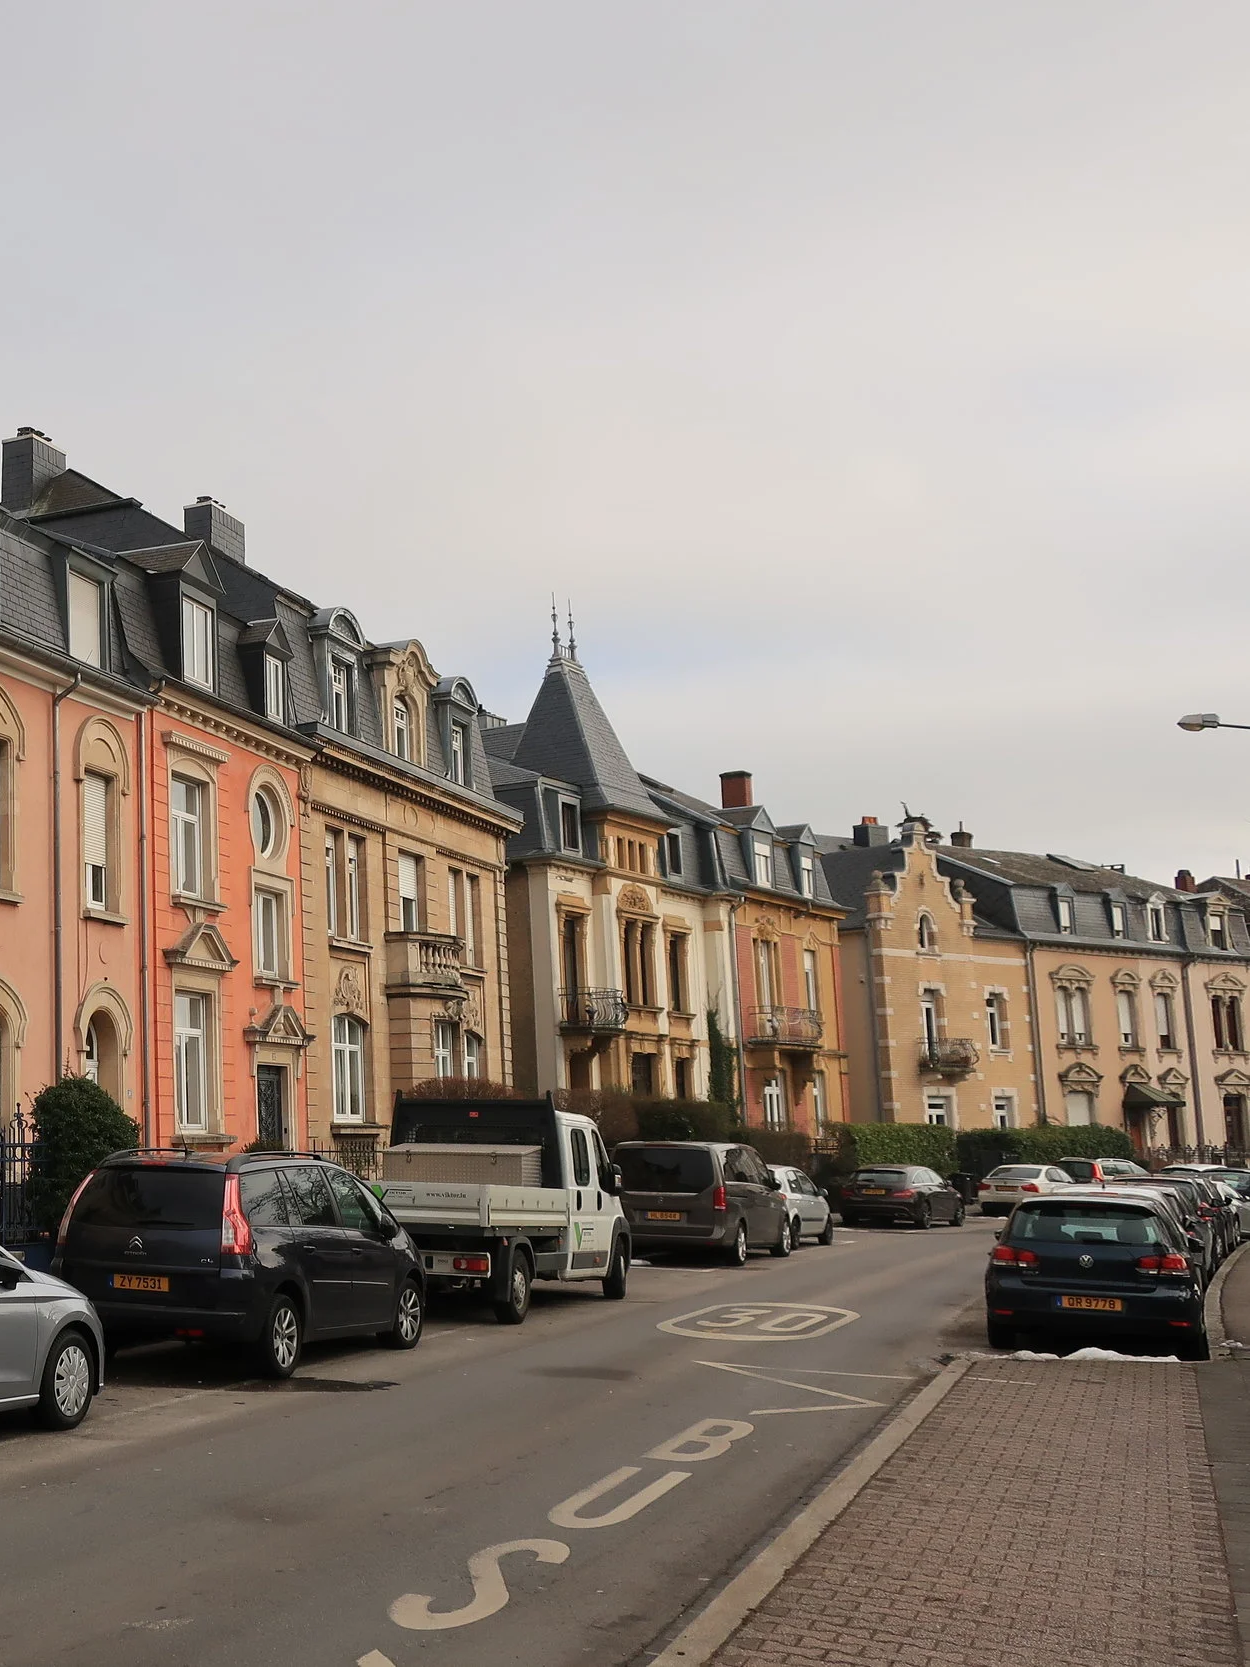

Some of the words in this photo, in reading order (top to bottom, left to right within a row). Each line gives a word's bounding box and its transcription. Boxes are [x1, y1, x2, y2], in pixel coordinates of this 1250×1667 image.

[426, 1191, 467, 1199] www.viktor.lu
[120, 1276, 133, 1287] ZY
[135, 1277, 162, 1290] 7531
[1085, 1298, 1115, 1309] 9778
[696, 1308, 830, 1333] 30
